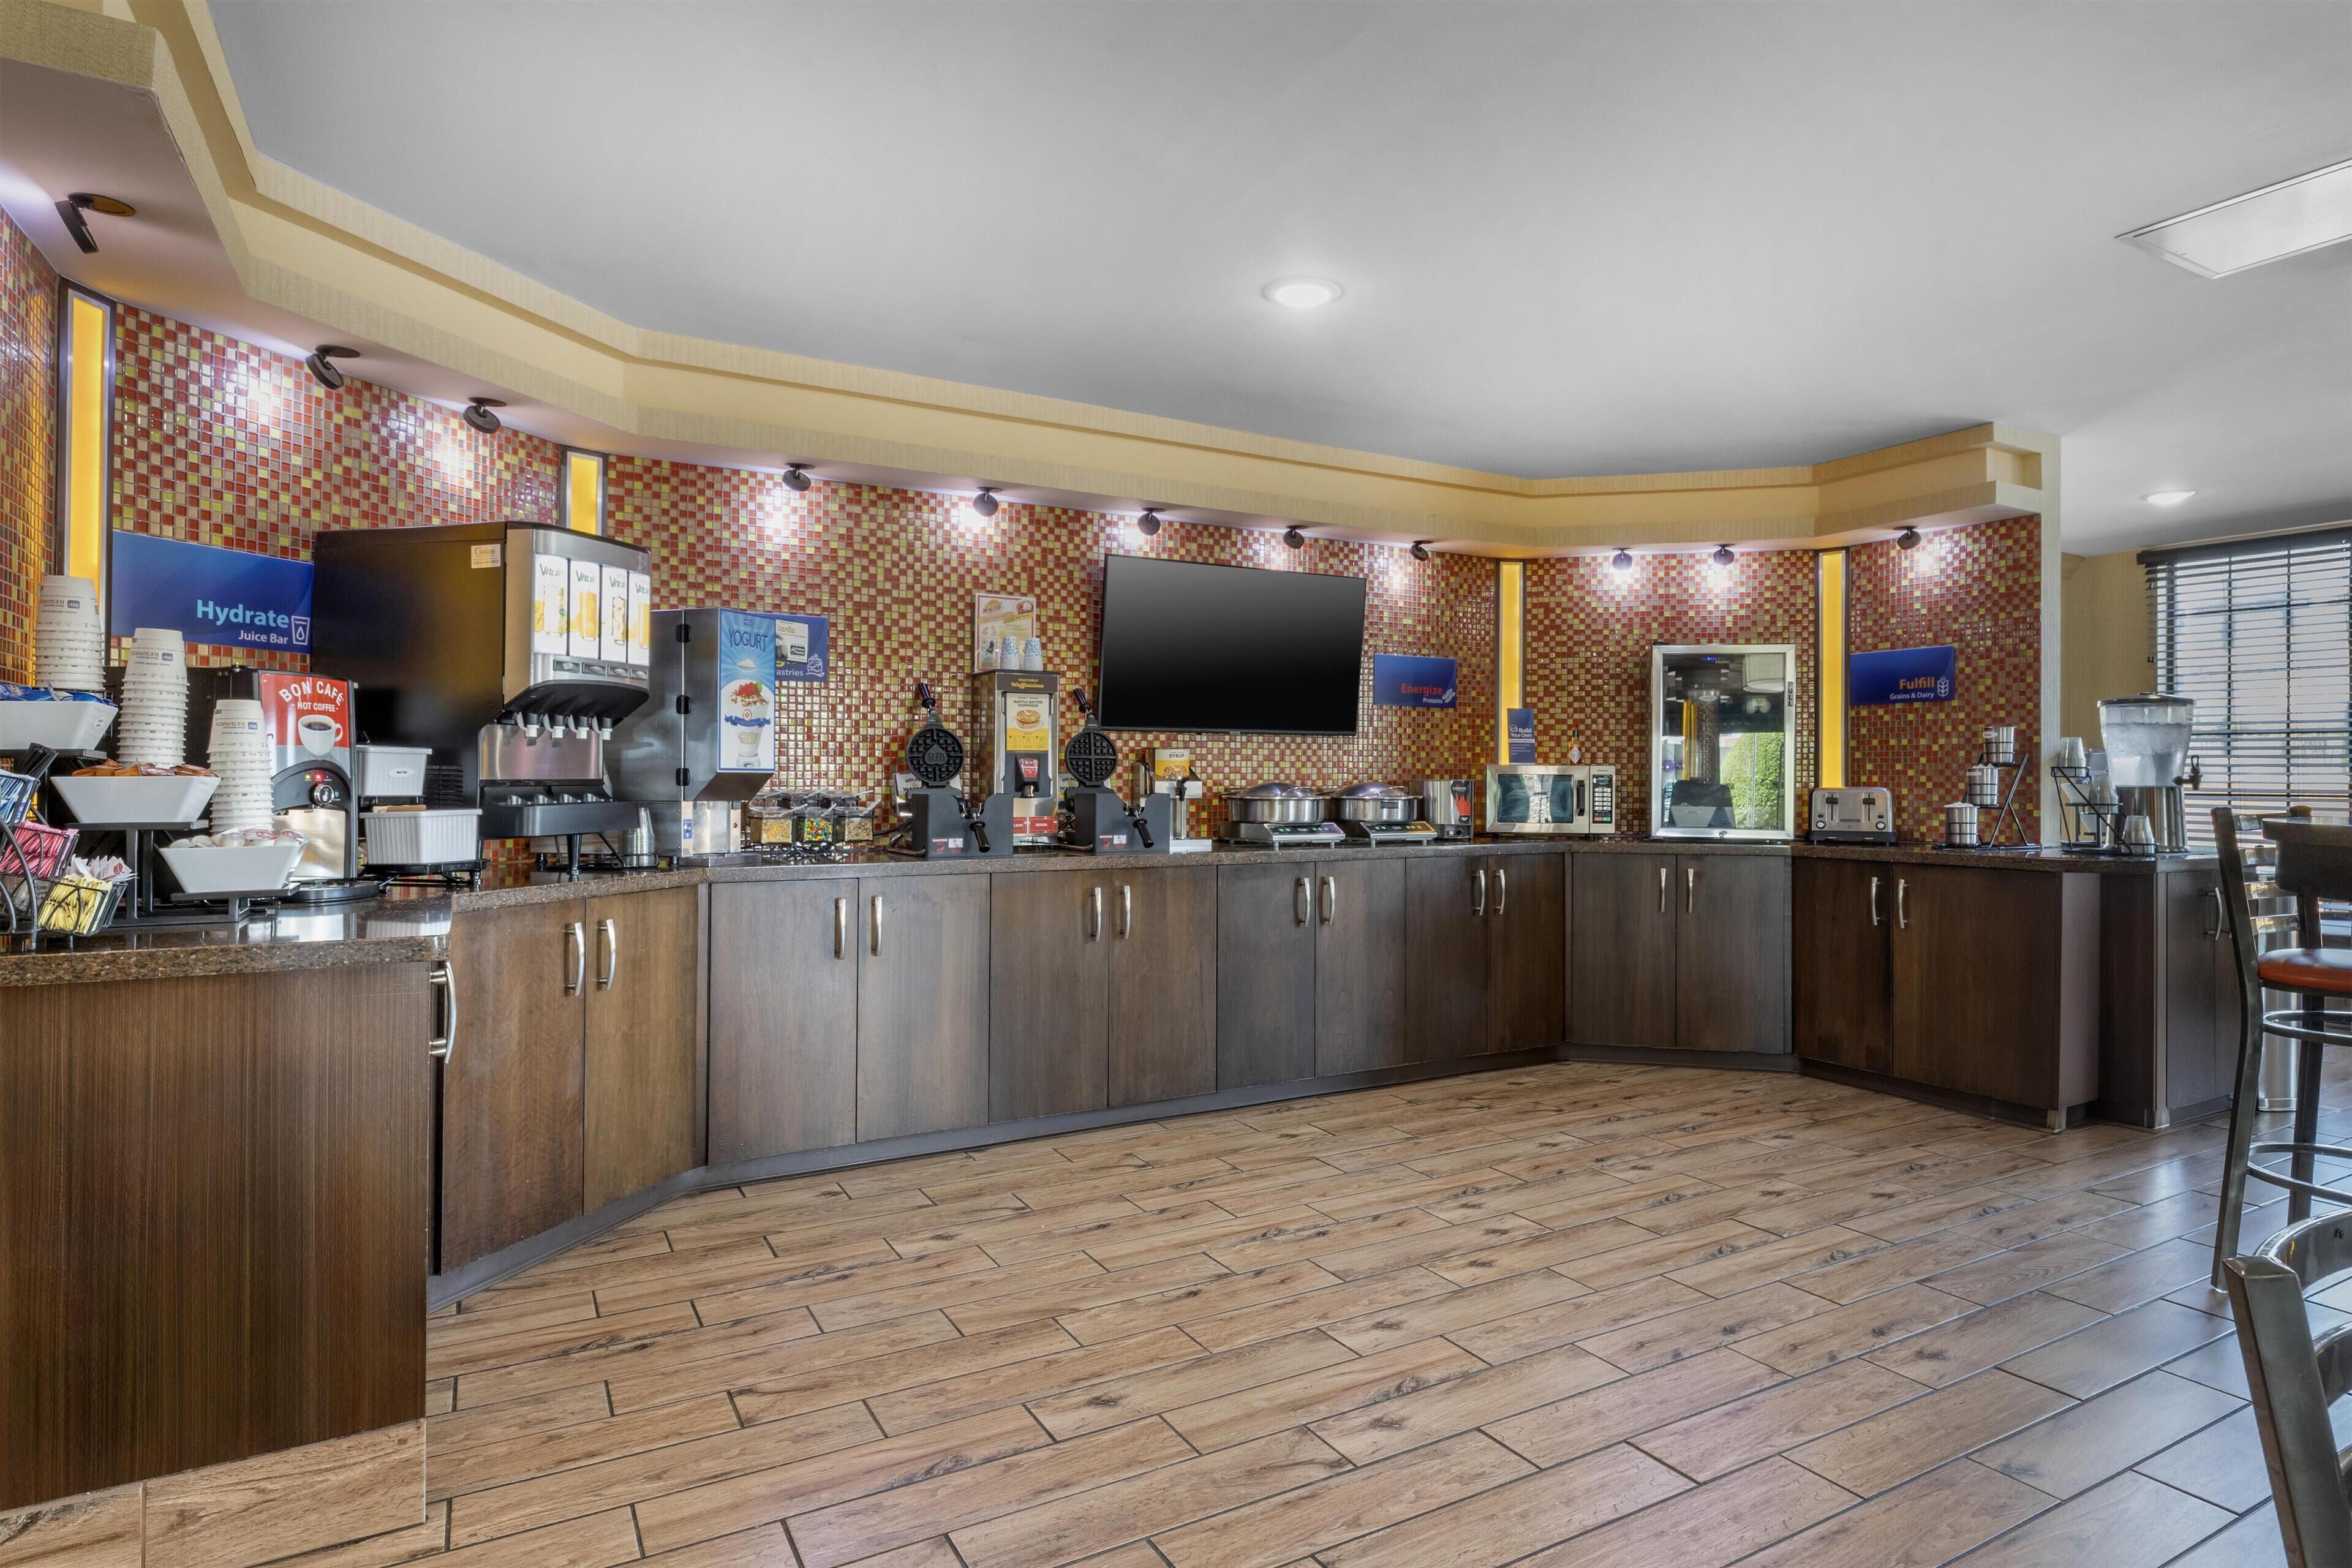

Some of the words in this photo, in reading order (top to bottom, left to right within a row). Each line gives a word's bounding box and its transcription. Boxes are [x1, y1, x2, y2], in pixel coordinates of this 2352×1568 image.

[197, 600, 289, 628] Hydrate
[777, 625, 795, 633] Vanilla
[238, 630, 267, 642] Juice
[270, 633, 288, 644] Bar
[729, 629, 768, 653] YOGURT
[1401, 683, 1442, 696] Energize
[1899, 677, 1934, 690] Fulfill
[278, 681, 311, 703] BON
[316, 680, 344, 706] CAFÉ
[313, 703, 336, 712] COFFEE
